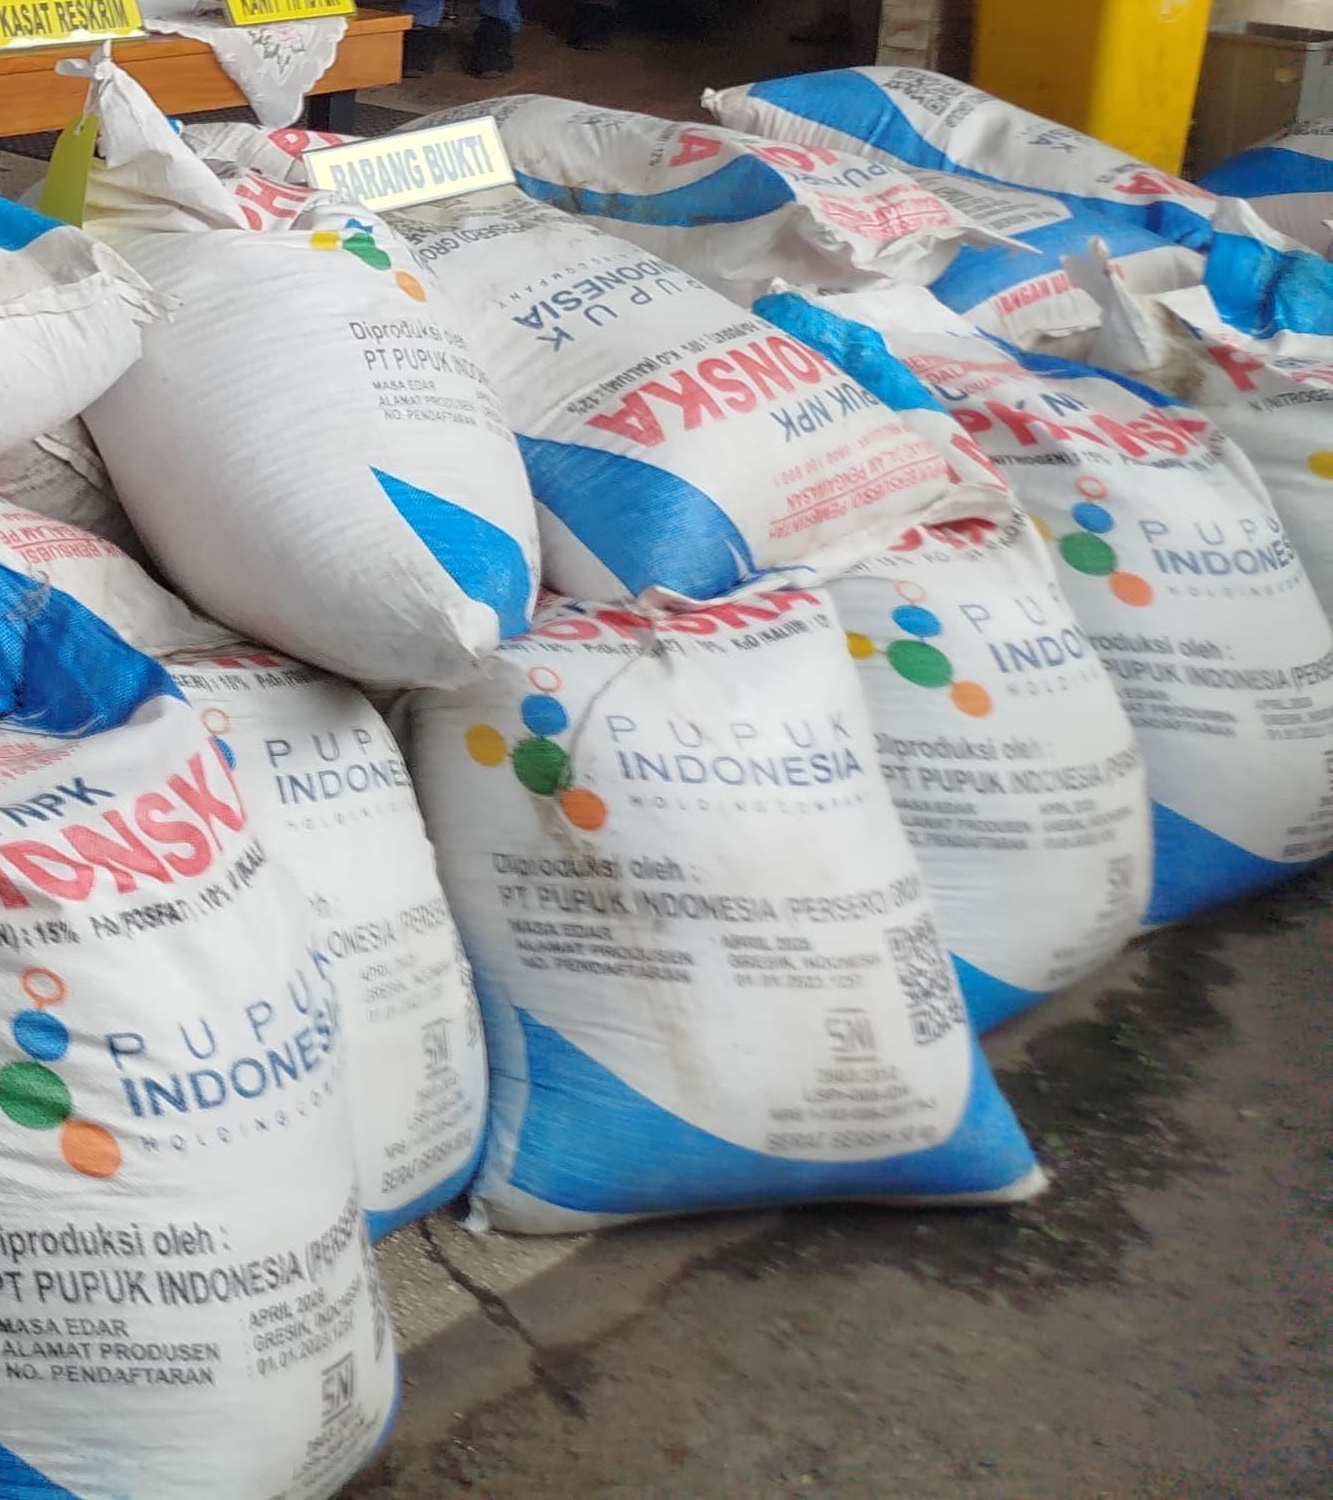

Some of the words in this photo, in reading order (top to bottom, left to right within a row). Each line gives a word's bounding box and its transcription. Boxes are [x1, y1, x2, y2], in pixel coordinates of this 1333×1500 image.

[0, 2, 52, 40] KASAT
[331, 148, 426, 198] BARANG
[429, 134, 495, 185] BUKTI
[350, 320, 441, 346] Diproduksi
[364, 349, 388, 371] PT
[392, 350, 450, 376] PUPUK
[585, 333, 831, 449] ONSKA
[769, 388, 834, 444] NPK
[605, 712, 854, 749] PUPUK
[615, 750, 867, 789] INDONESIA
[4, 777, 117, 831] NPK
[104, 942, 331, 1069] PUPUK
[153, 1225, 213, 1255] oleh
[36, 1267, 153, 1306] PUPUK
[161, 1251, 303, 1306] INDONESIA
[64, 1316, 128, 1337] EDAR
[2, 1340, 90, 1362] ALAMAT
[99, 1342, 222, 1363] PRODUSEN
[52, 1364, 216, 1385] PENDAFTARAN
